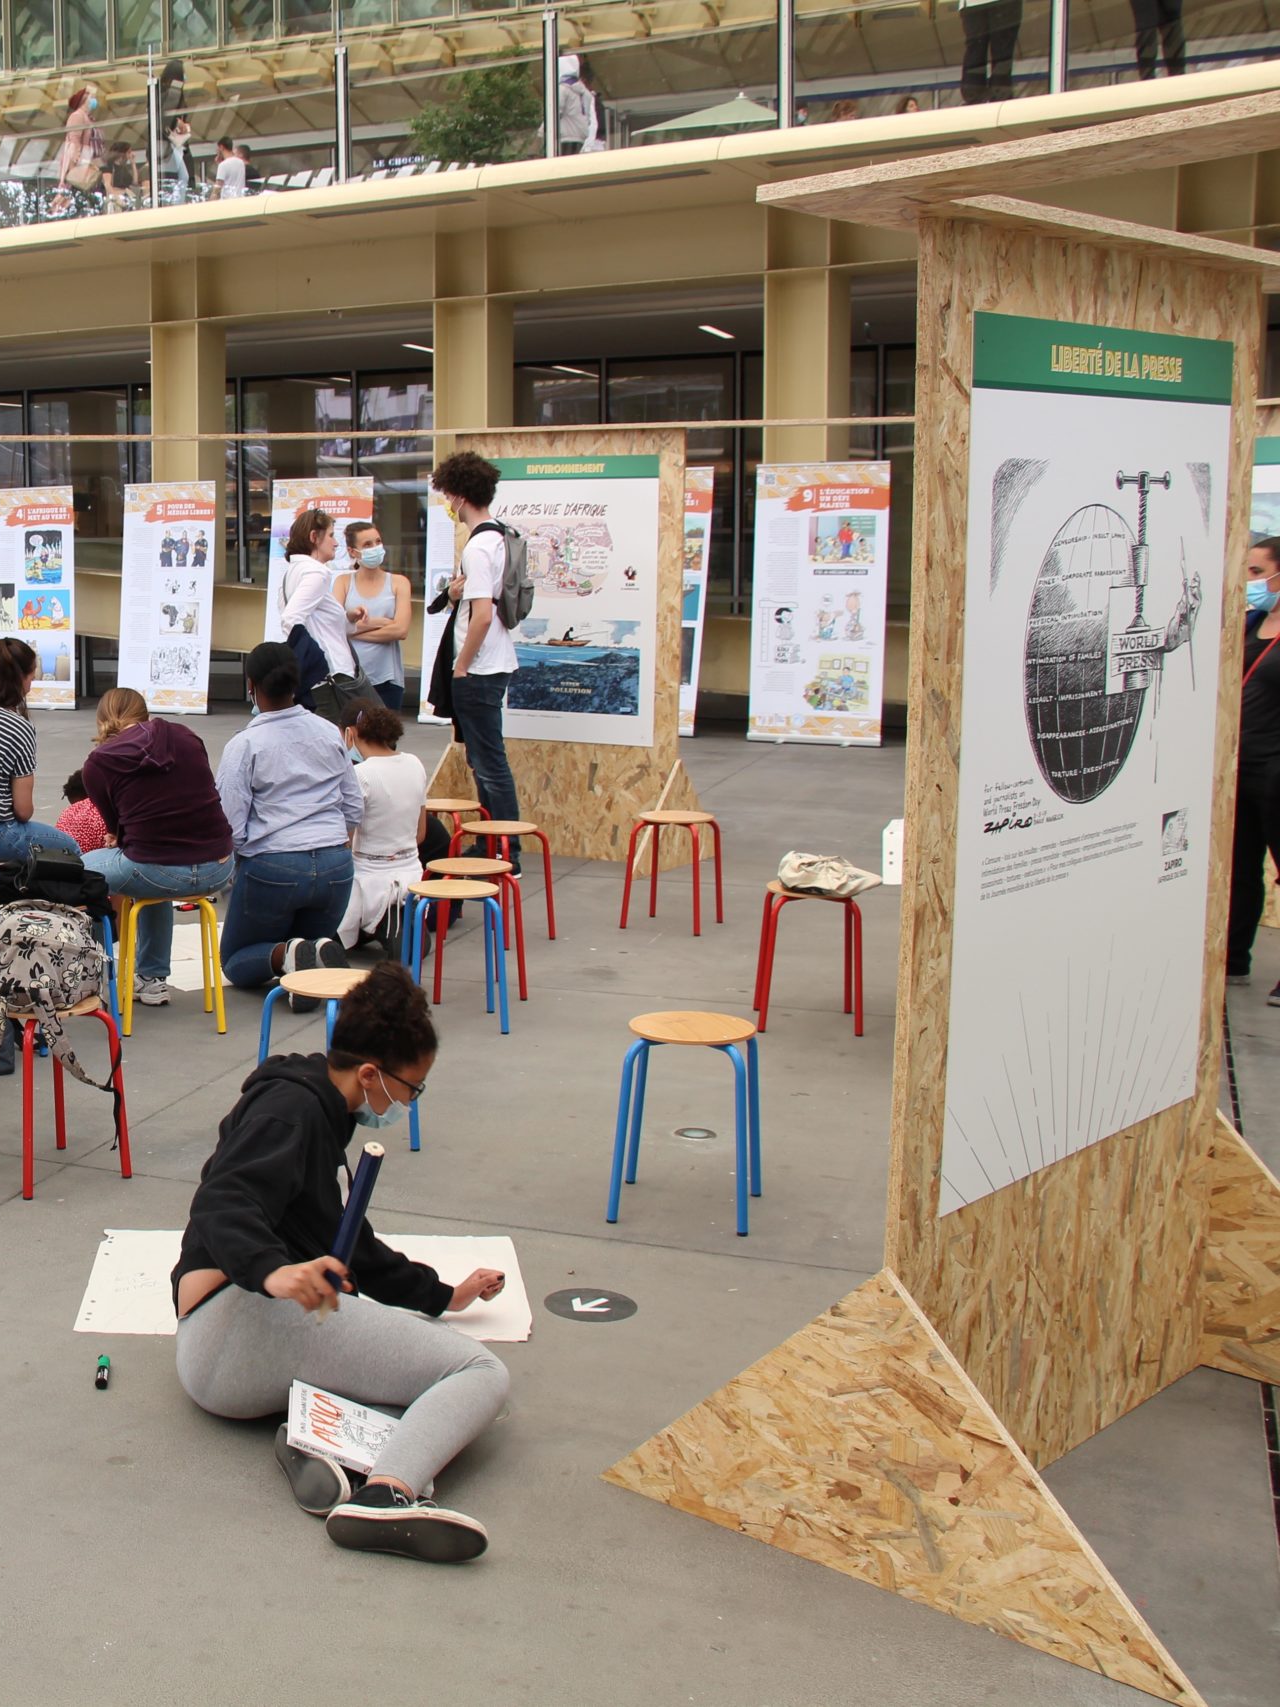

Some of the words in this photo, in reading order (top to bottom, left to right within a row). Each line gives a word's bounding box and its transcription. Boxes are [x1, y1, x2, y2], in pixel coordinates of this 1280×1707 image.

[372, 159, 385, 168] LE
[388, 154, 438, 166] CHOCOL
[1050, 342, 1103, 376] LIBERTÉ
[1105, 350, 1122, 378] DE
[1123, 352, 1140, 379] LA
[1142, 354, 1184, 383] PRESSE
[526, 463, 605, 474] ENVIRONNEMENT
[802, 489, 813, 502] 9
[819, 487, 870, 495] L'ÉDUCATION
[16, 509, 23, 520] 4
[156, 504, 163, 515] 5
[496, 505, 507, 518] LA
[510, 504, 528, 516] COP
[528, 504, 542, 515] 25
[543, 503, 562, 516] VUE
[563, 503, 608, 517] D'AFRIQUE
[1118, 633, 1160, 651] WORLD
[1069, 654, 1077, 662] OF
[1117, 654, 1156, 672] PRESS
[308, 1392, 344, 1449] AFRICA
